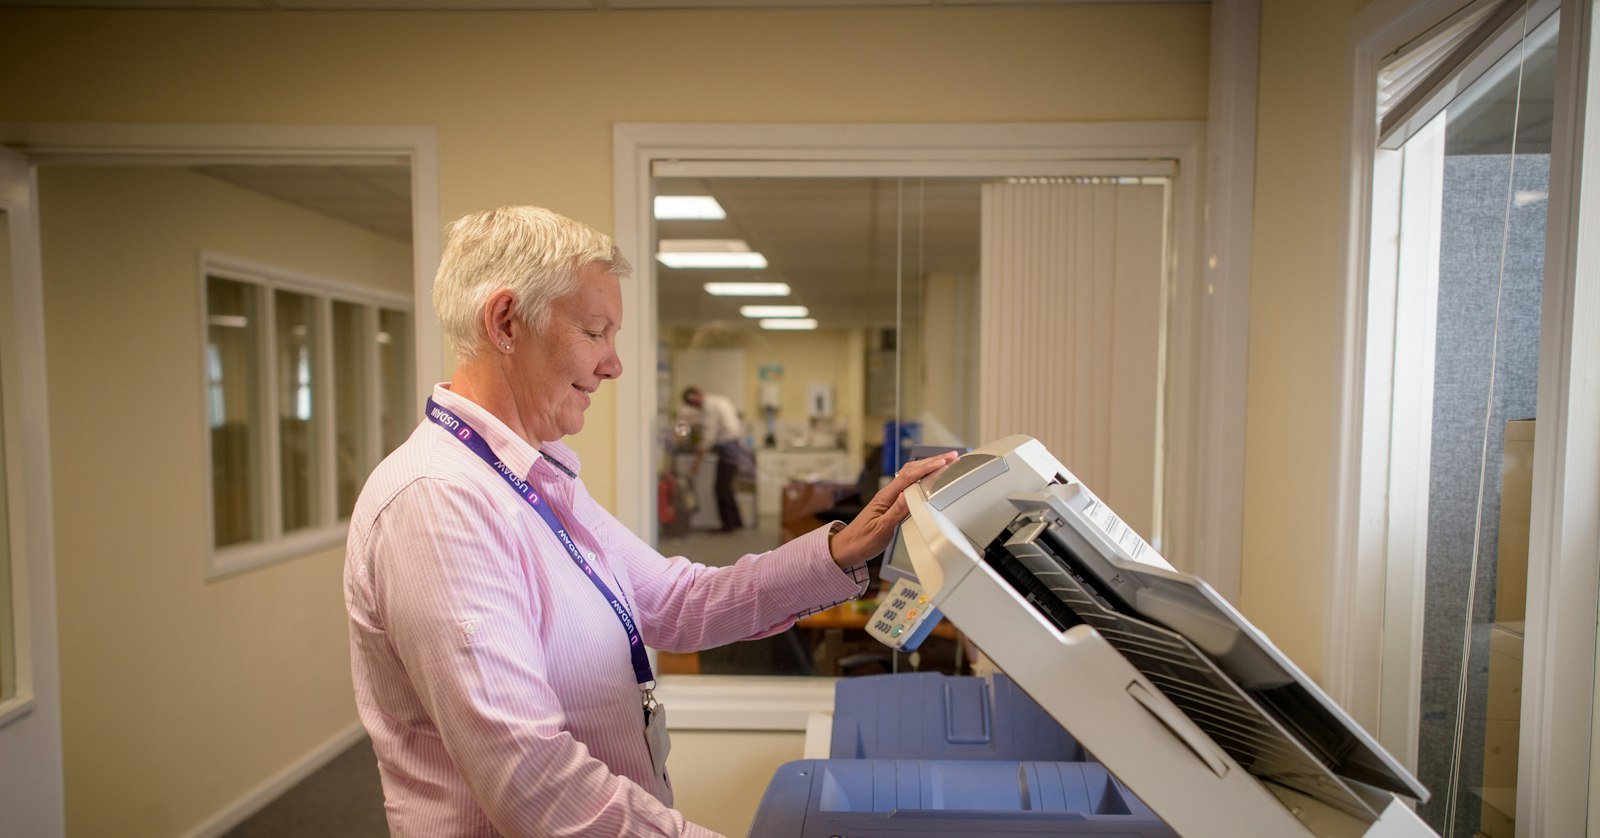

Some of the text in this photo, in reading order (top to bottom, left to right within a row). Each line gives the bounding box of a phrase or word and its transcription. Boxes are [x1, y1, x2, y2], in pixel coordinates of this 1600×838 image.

[459, 428, 470, 439] U
[494, 460, 539, 503] U USDAW
[557, 529, 593, 575] U USDAW
[611, 599, 639, 645] U USDAW
